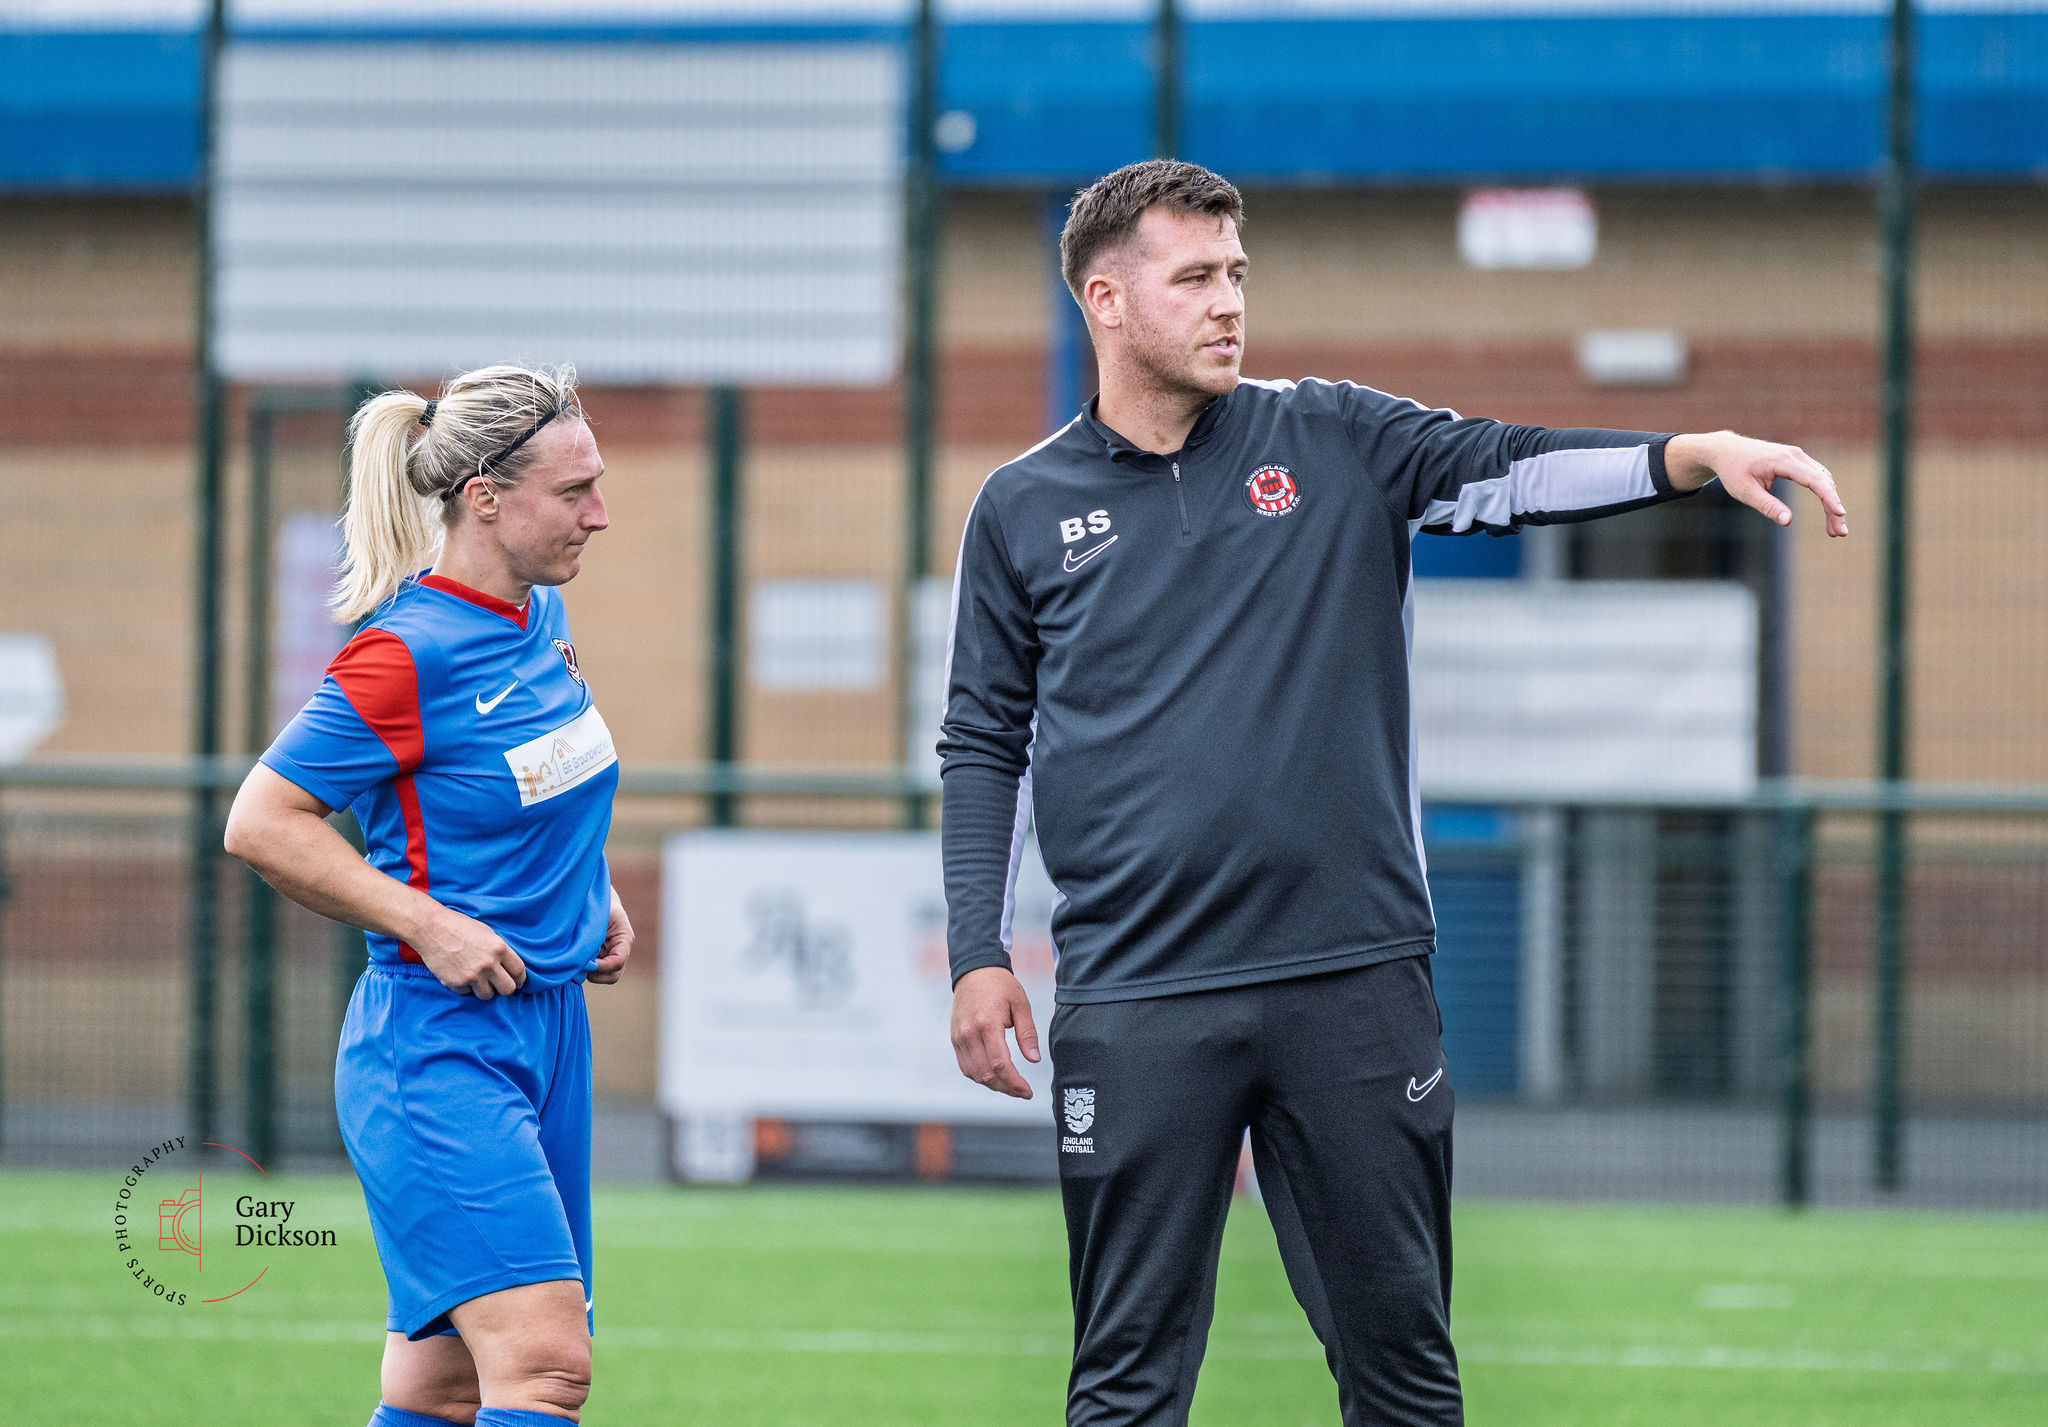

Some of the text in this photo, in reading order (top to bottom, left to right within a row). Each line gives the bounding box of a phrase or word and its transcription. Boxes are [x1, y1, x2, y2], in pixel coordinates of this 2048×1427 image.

[1246, 465, 1289, 486] SUNDERLAND
[1257, 508, 1277, 517] WEST
[1280, 506, 1292, 516] END
[1060, 509, 1111, 543] BS
[1063, 1137, 1093, 1145] ENGLAND
[1062, 1145, 1095, 1154] FOOTBALL
